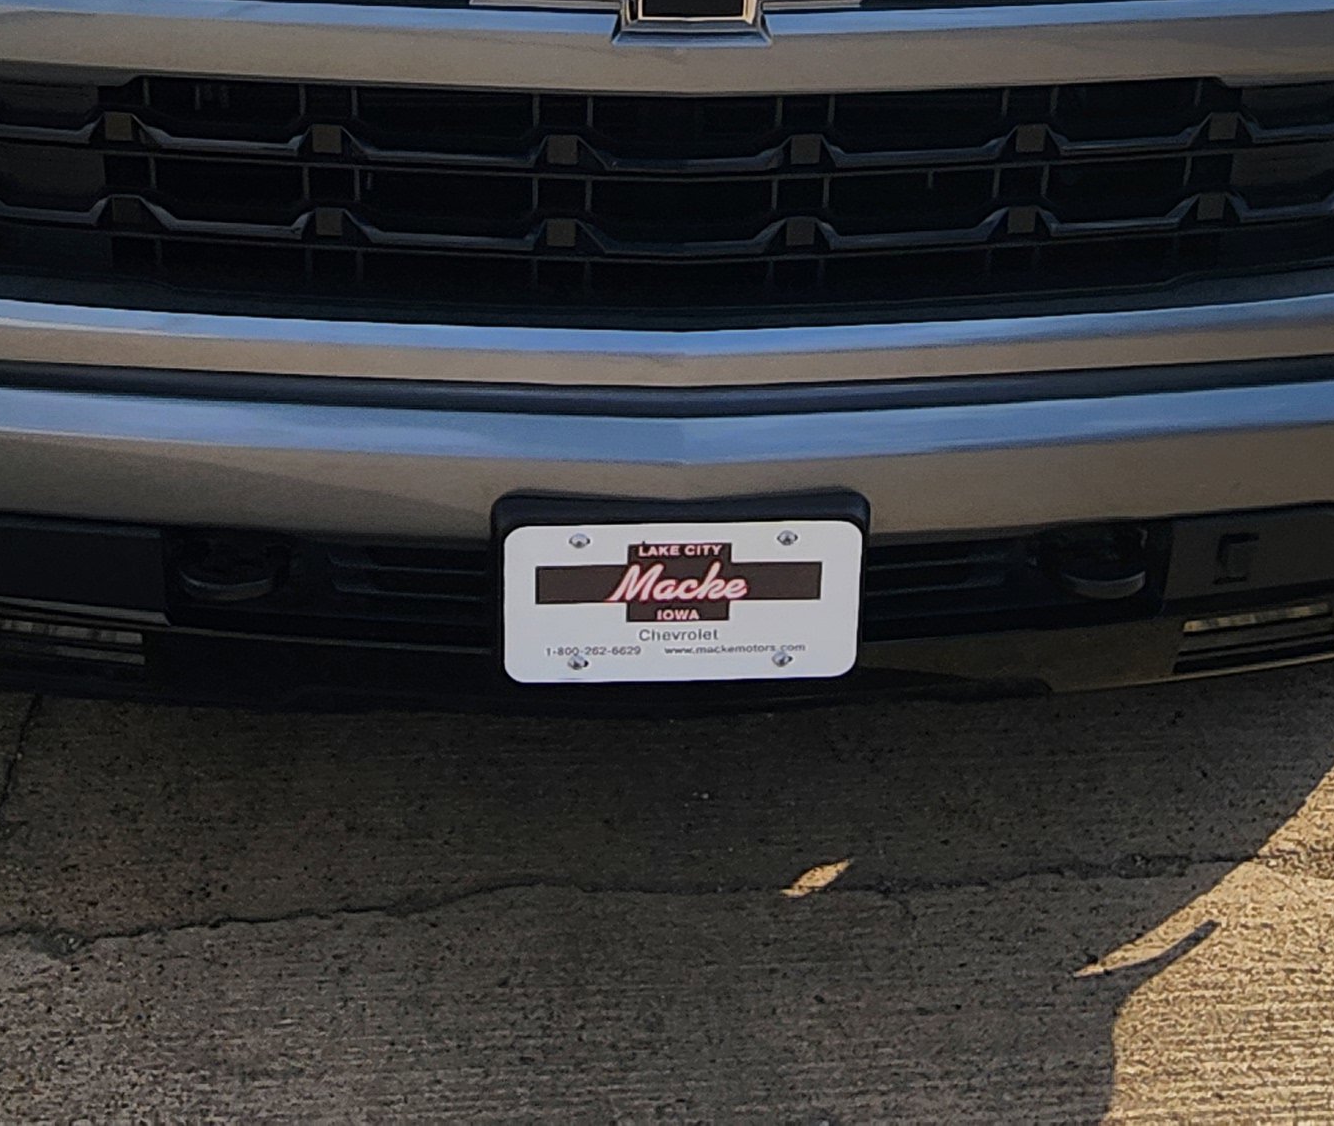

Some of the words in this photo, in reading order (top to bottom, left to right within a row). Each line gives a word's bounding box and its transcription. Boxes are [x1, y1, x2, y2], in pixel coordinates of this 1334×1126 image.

[638, 545, 680, 556] LAKE
[684, 544, 722, 556] CITY
[605, 561, 748, 602] Macke
[656, 609, 700, 620] IOWA
[638, 628, 719, 642] Chevrolet
